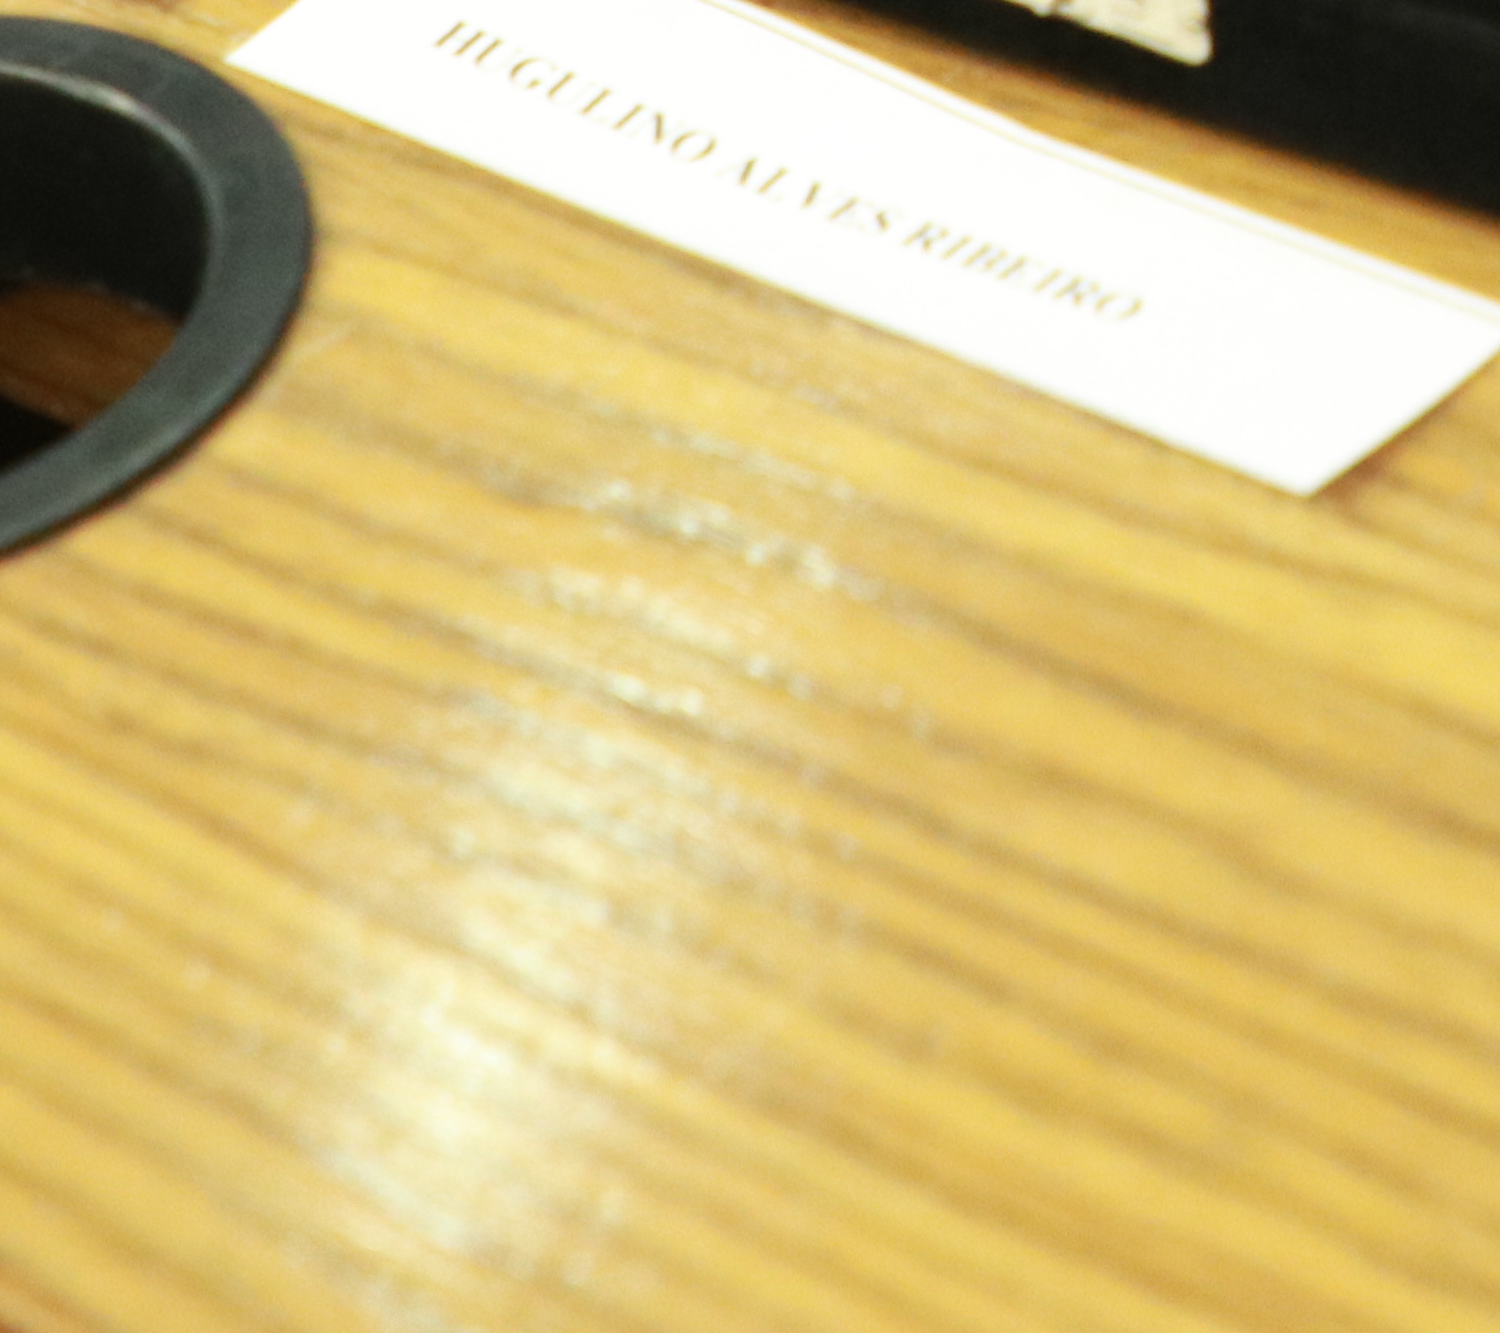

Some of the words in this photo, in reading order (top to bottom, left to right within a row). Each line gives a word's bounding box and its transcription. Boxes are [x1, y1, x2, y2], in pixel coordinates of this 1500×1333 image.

[430, 18, 720, 165] HUGULINO
[713, 153, 906, 236] ALVES
[900, 219, 1146, 323] RIBEIRO
